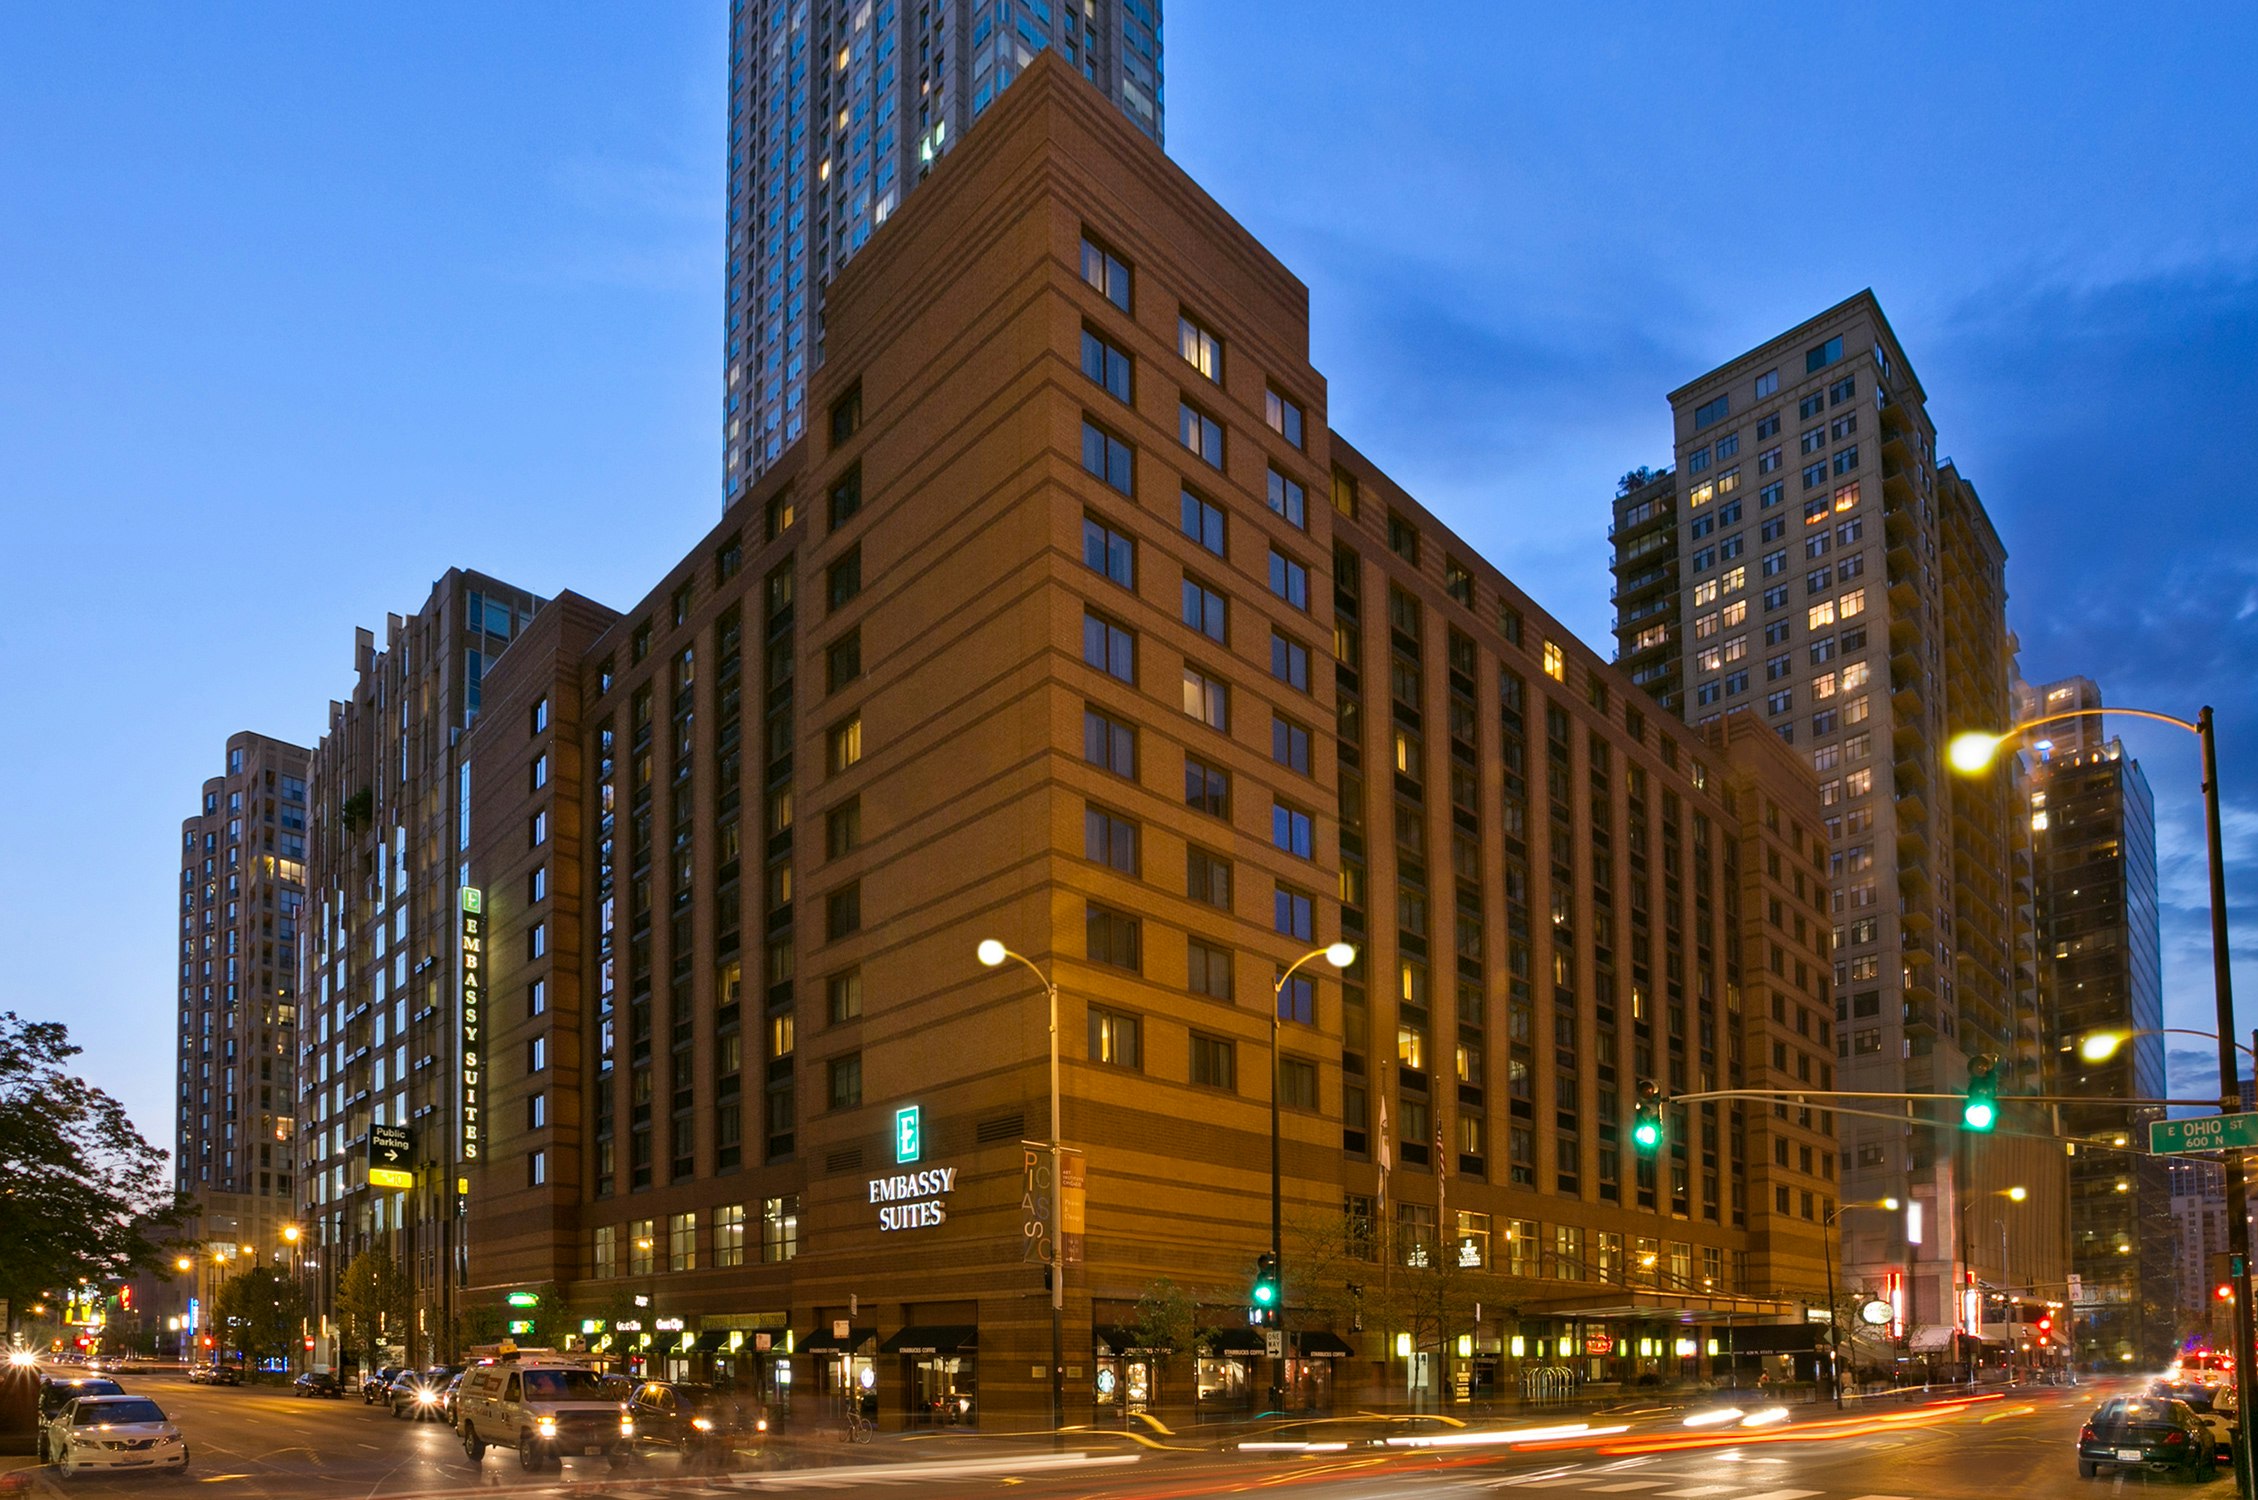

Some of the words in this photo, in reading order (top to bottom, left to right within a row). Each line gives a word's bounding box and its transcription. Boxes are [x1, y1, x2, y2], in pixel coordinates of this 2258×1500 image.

[462, 918, 480, 1041] EMBASSY
[464, 1052, 478, 1158] SUITES
[376, 1127, 406, 1139] Public
[2168, 1127, 2175, 1136] E
[2183, 1120, 2222, 1136] OHIO
[2230, 1120, 2243, 1130] ST
[373, 1136, 410, 1150] Parking
[2186, 1137, 2209, 1147] 600
[2215, 1136, 2224, 1145] N
[869, 1167, 955, 1203] EMBASSY
[879, 1200, 944, 1231] SUITES
[1267, 1332, 1281, 1341] ONE
[1267, 1341, 1281, 1349] WAY
